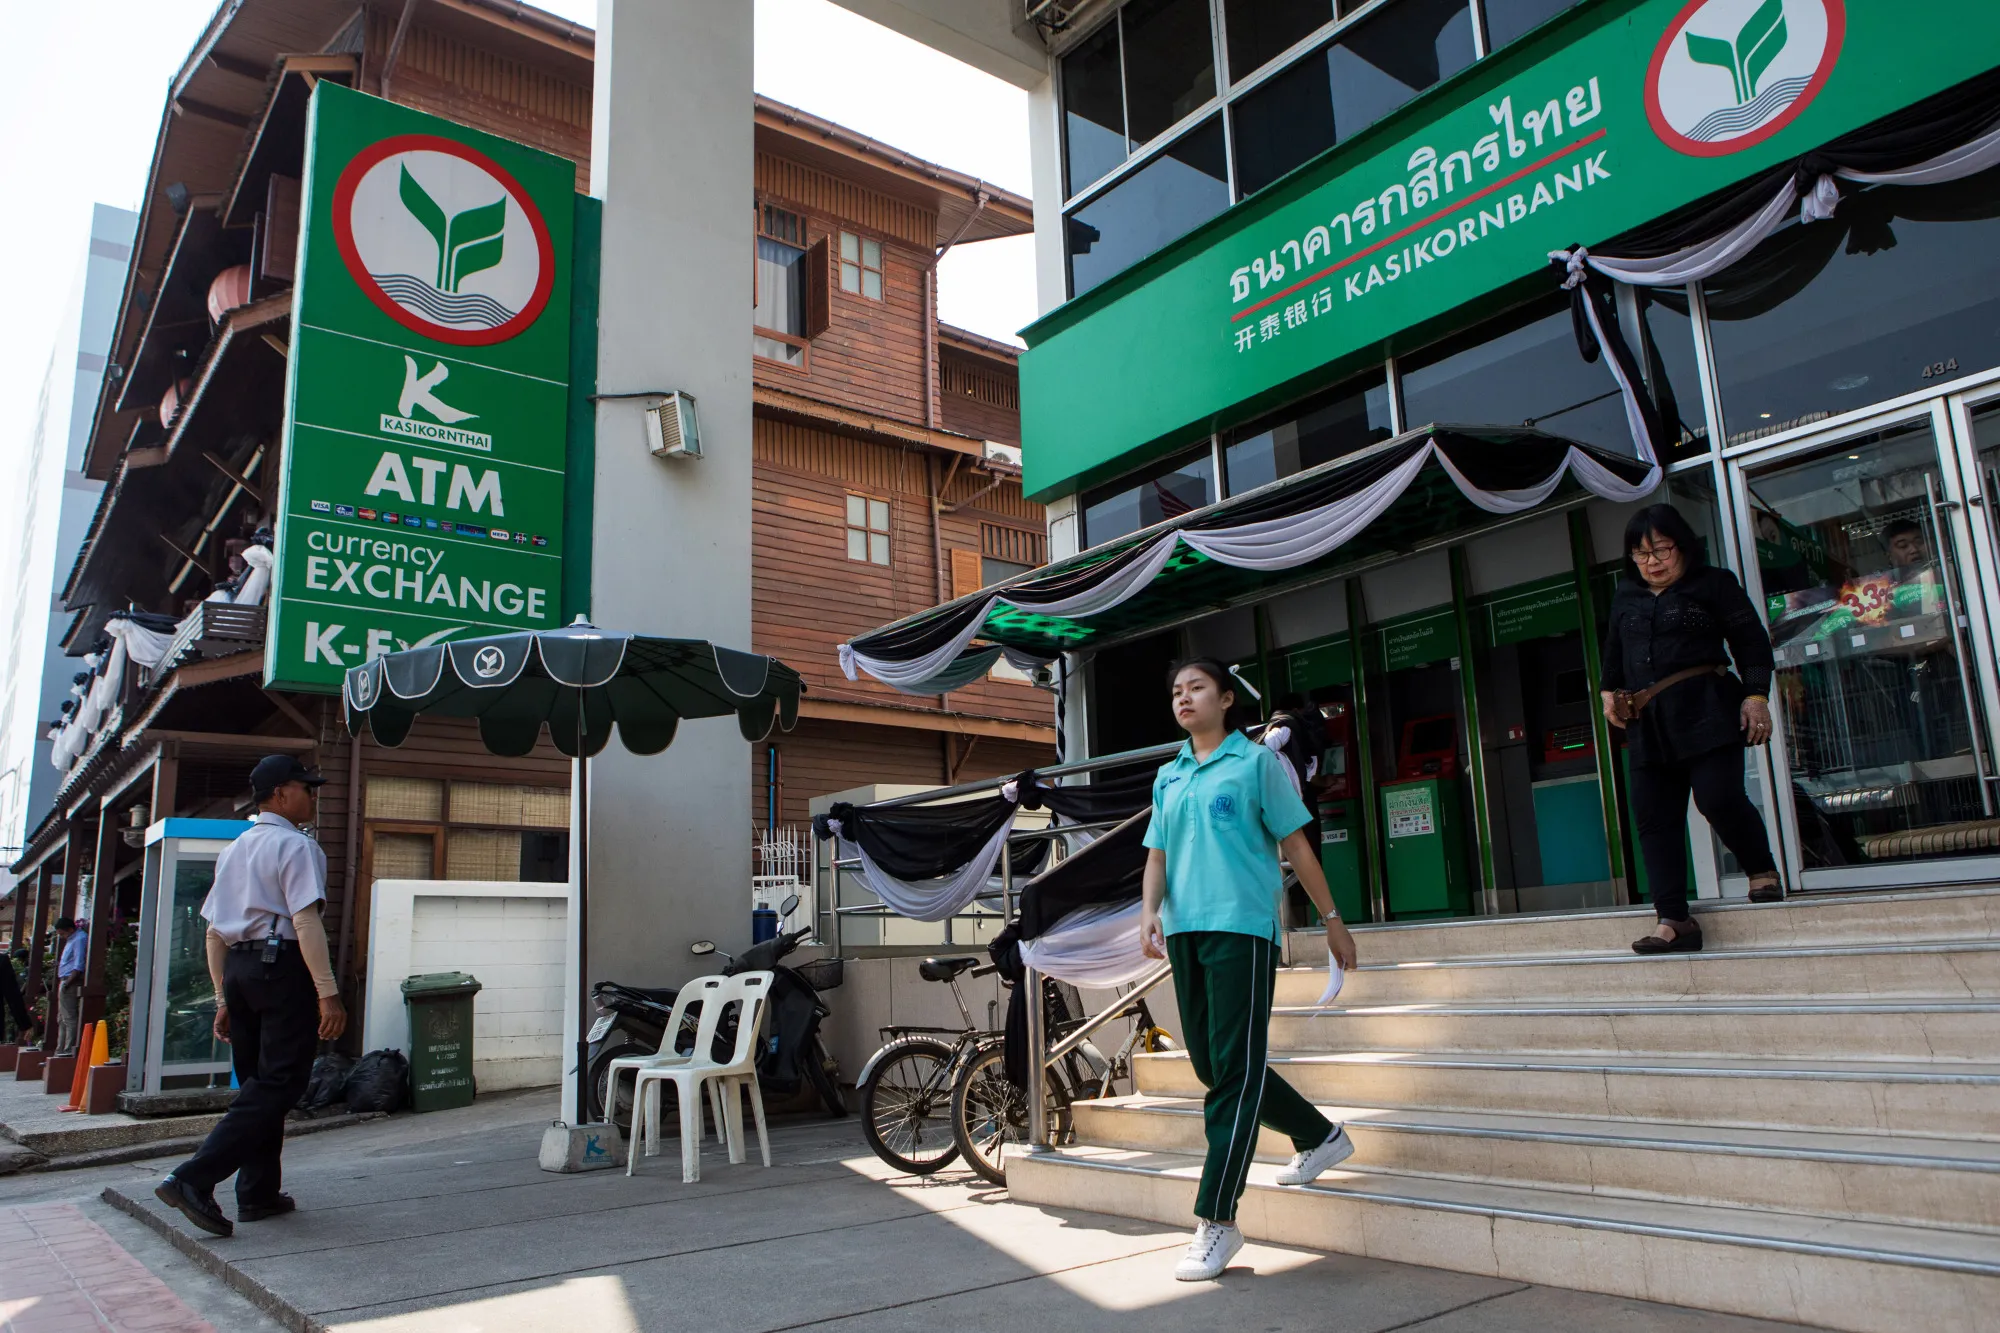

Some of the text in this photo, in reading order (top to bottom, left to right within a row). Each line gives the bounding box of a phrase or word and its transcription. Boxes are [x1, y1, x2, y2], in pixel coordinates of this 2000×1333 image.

[1229, 76, 1602, 303] ธนาคารกสิกรไทย
[1234, 150, 1611, 353] 开泰银行 KASIKORNBANK
[398, 354, 480, 424] K
[1922, 357, 1959, 379] 434
[384, 417, 489, 449] KASIKORNTHAI
[313, 502, 329, 510] VISA
[364, 451, 504, 517] ATM
[307, 530, 445, 575] currency
[306, 556, 546, 619] EXCHANGE
[1842, 583, 1894, 617] 3.3%
[1326, 833, 1338, 841] VISA
